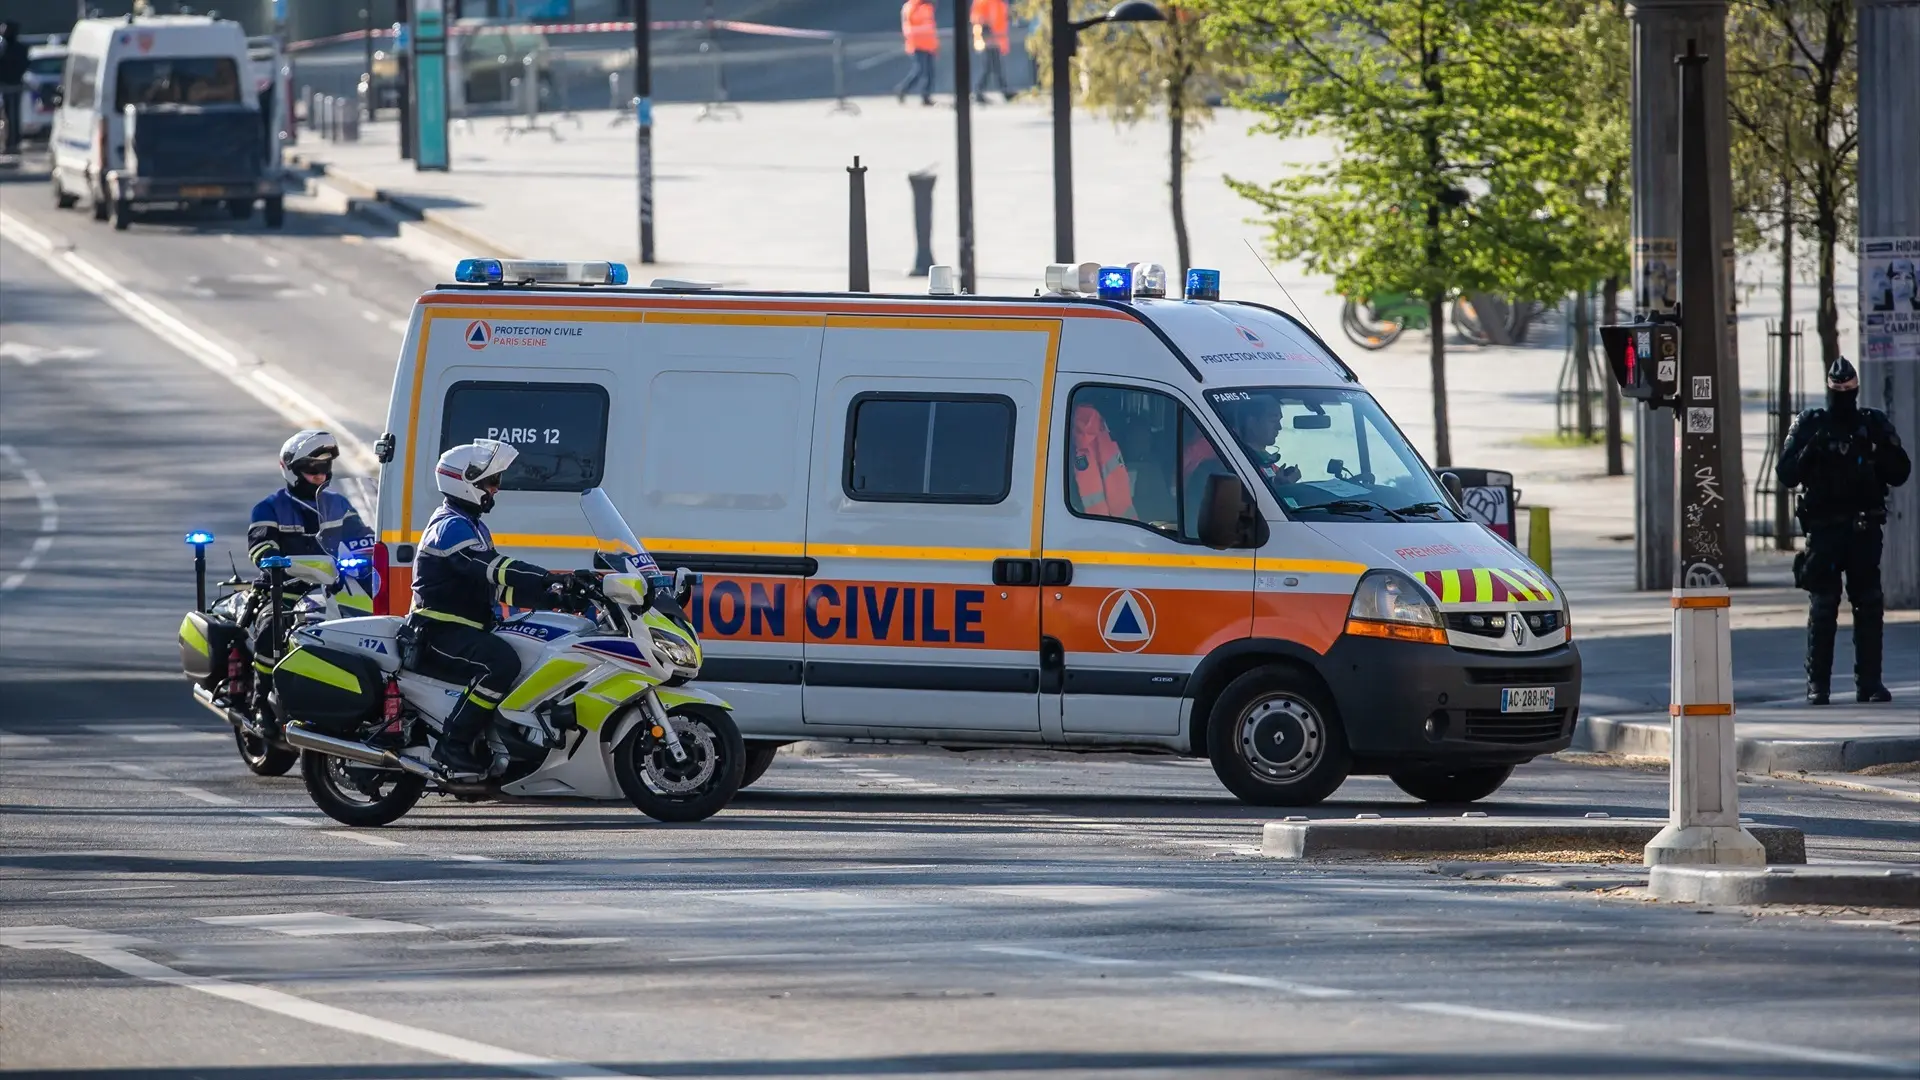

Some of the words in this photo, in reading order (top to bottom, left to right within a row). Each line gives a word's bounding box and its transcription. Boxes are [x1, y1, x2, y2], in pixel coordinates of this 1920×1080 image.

[1896, 240, 1920, 252] HIDA
[494, 326, 552, 336] PROTECTION
[553, 327, 583, 336] CIVILE
[493, 337, 519, 346] PARIS
[521, 338, 547, 347] SEINE
[1201, 352, 1257, 364] PROTECTION
[1256, 351, 1287, 362] CIVILE
[1213, 392, 1240, 402] PARIS
[1239, 391, 1251, 400] 12
[487, 427, 537, 443] PARIS
[543, 428, 561, 444] 12
[805, 584, 985, 644] CIVILE
[1508, 689, 1550, 707] AC-288-HG
